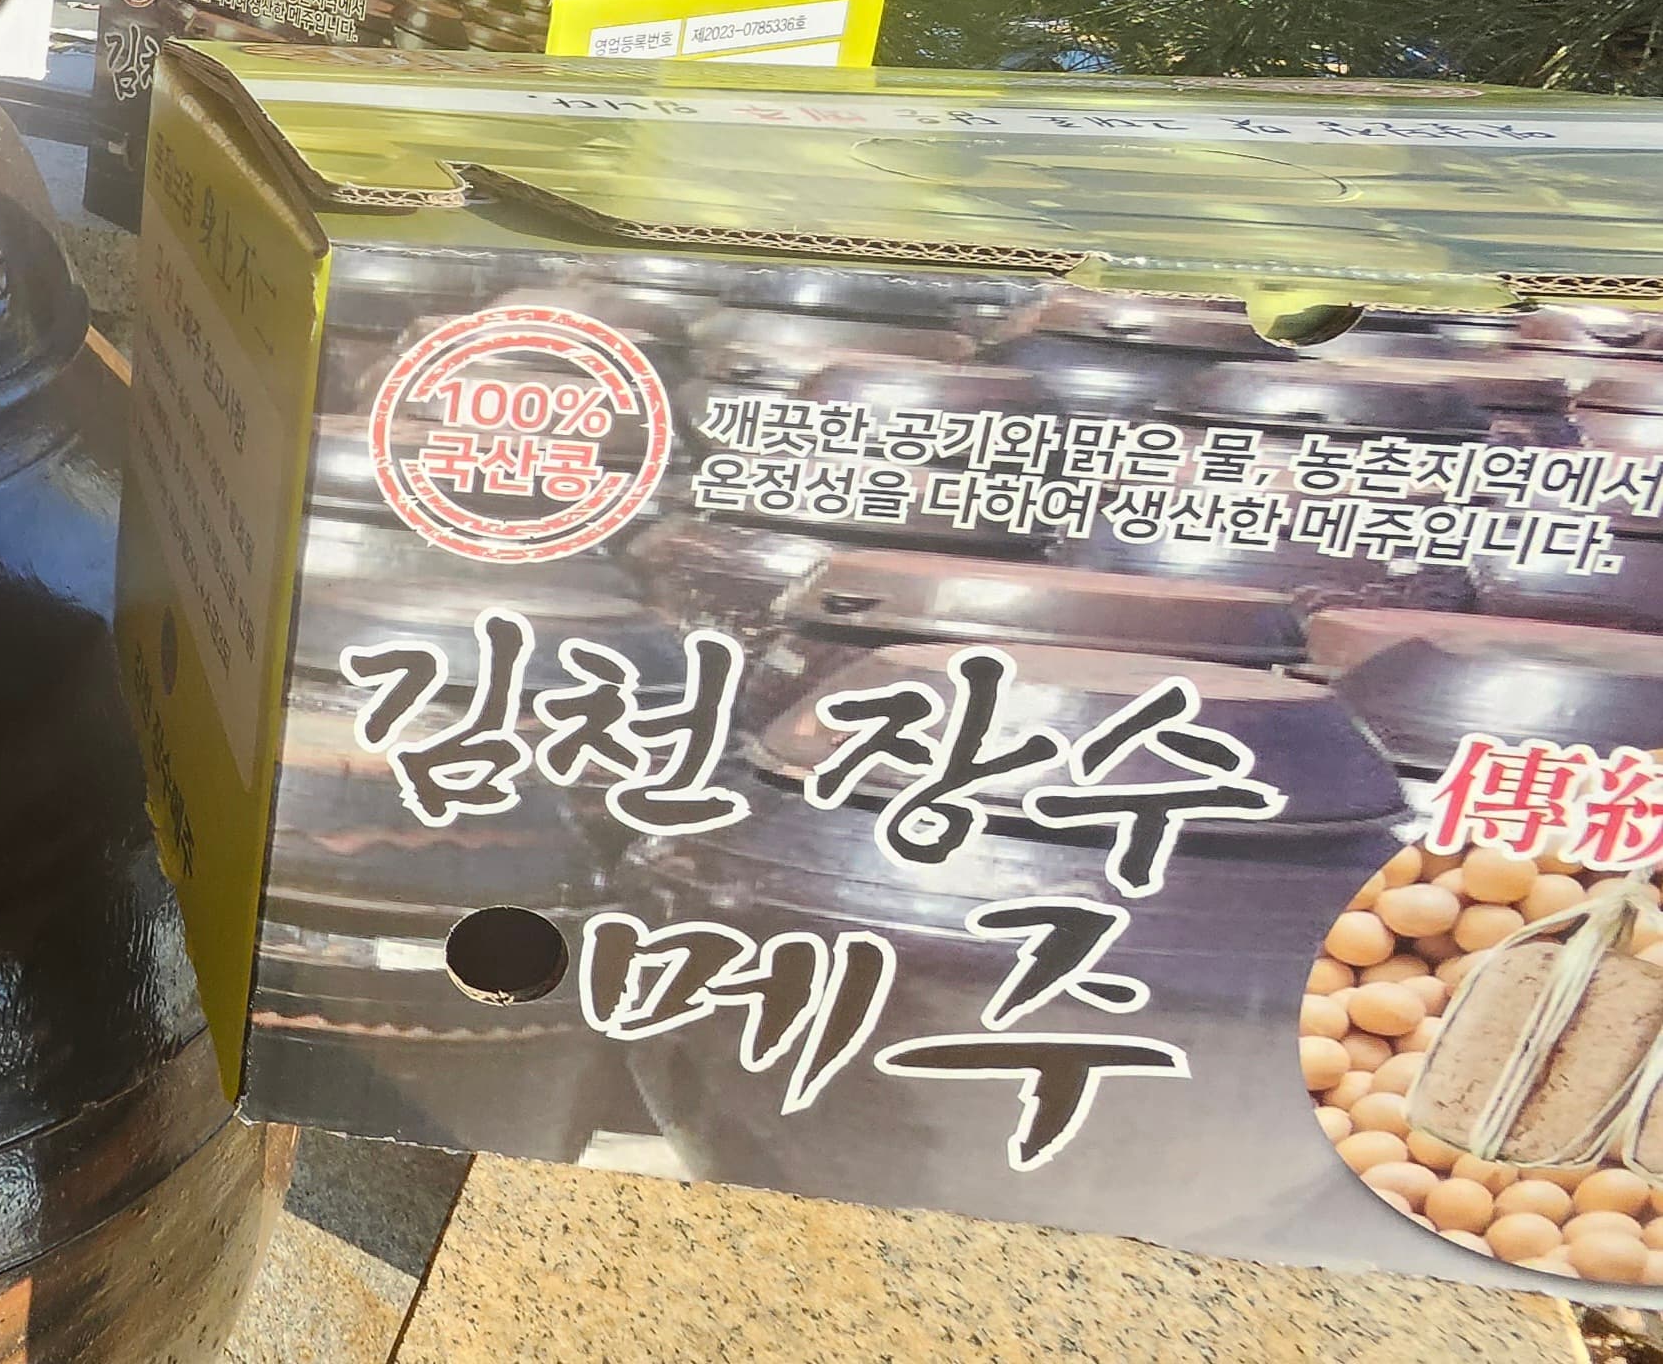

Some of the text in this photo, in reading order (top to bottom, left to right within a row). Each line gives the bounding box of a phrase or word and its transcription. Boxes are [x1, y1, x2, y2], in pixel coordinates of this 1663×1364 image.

[593, 30, 674, 58] 영업등록번호
[436, 379, 612, 437] 100%
[420, 434, 604, 501] 국산콩
[705, 400, 1663, 517] 깨끗한 공기와 맑은 물, 농촌지역에서
[692, 452, 1625, 576] 온정성을 다하여 생산한 메주입니다.
[341, 607, 1288, 898] 김천 장수
